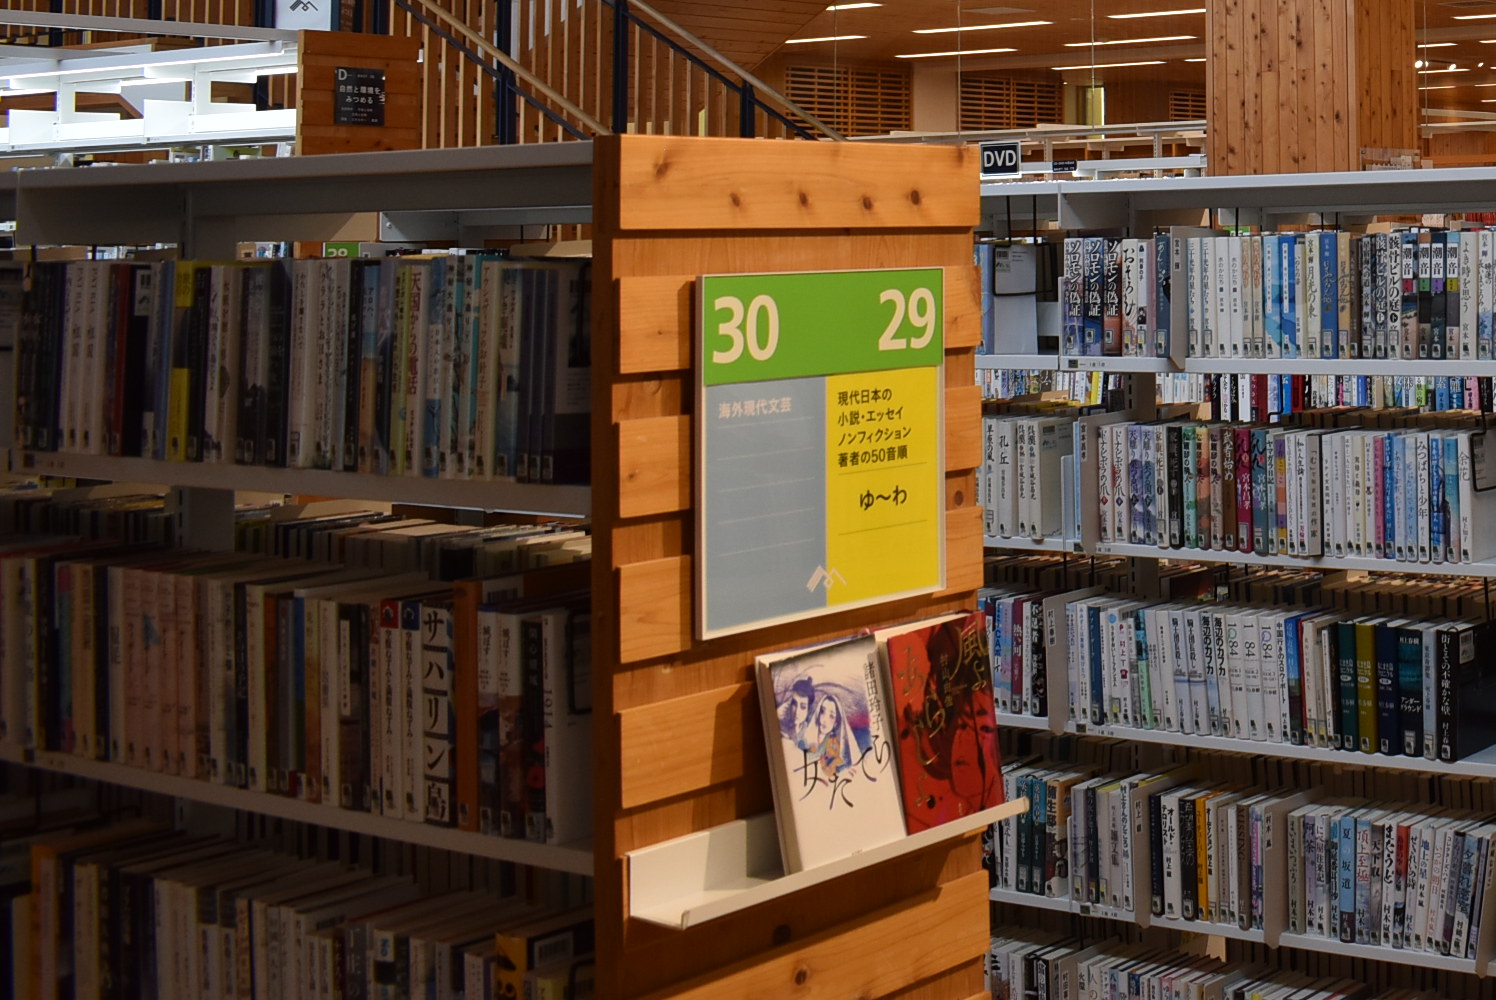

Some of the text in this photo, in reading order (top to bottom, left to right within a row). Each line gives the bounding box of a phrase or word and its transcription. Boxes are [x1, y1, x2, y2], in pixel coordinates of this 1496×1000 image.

[338, 69, 347, 80] D
[339, 85, 381, 95] 自然と環境を
[345, 96, 373, 104] みつめる
[983, 150, 1017, 168] DVD
[1069, 240, 1081, 317] ソロモンの偽証
[1088, 240, 1102, 317] ソロモンの偽証
[1106, 240, 1119, 317] ソロモンの偽証
[1388, 236, 1400, 312] 骸骨ビルの庭
[1403, 248, 1413, 276] 潮音
[1420, 247, 1430, 275] 潮音
[1432, 247, 1443, 275] 潮音
[1446, 247, 1458, 275] 潮音
[1461, 241, 1471, 313] よき時を思う
[1307, 266, 1318, 319] 月光の東
[409, 271, 421, 395] 天国からの電話
[712, 286, 937, 365] 30 29
[718, 396, 792, 420] 海外現代文芸
[837, 387, 893, 407] 現代日本の
[837, 406, 904, 428] 小説・エッセイ
[837, 425, 912, 447] ノンフィクション
[837, 444, 909, 469] 著者の50音順
[986, 424, 994, 461] 草原の風
[1000, 435, 1009, 465] 孔丘
[1223, 430, 1234, 480] 武者始め
[1418, 440, 1428, 519] みつばちと少年
[1172, 618, 1180, 668] 騎士団長殺し
[1187, 618, 1196, 668] 騎士団長殺し
[1202, 616, 1214, 675] 海辺のカフカ
[1214, 617, 1226, 676] 海辺のカフカ
[1227, 623, 1239, 656] 1Q84
[1243, 624, 1256, 658] 184
[1261, 626, 1273, 660] 1Q84
[1276, 622, 1287, 705] 中国行きのスロウ・ボート
[862, 659, 882, 731] 諸田玲子
[1441, 633, 1451, 716] 街とその不確かな壁
[423, 610, 447, 820] サハリン島
[1046, 785, 1057, 828] 蒲生邸
[1120, 784, 1130, 849] 村上さんのところ
[1167, 807, 1176, 846] オールド・
[1237, 807, 1247, 860] MISSING
[1289, 821, 1297, 883] まいまいつぶろ
[1357, 829, 1370, 882] 頂上至極
[1384, 823, 1394, 885] またうど
[1341, 828, 1352, 890] 夏の坂道
[1420, 839, 1430, 880] 地上の星
